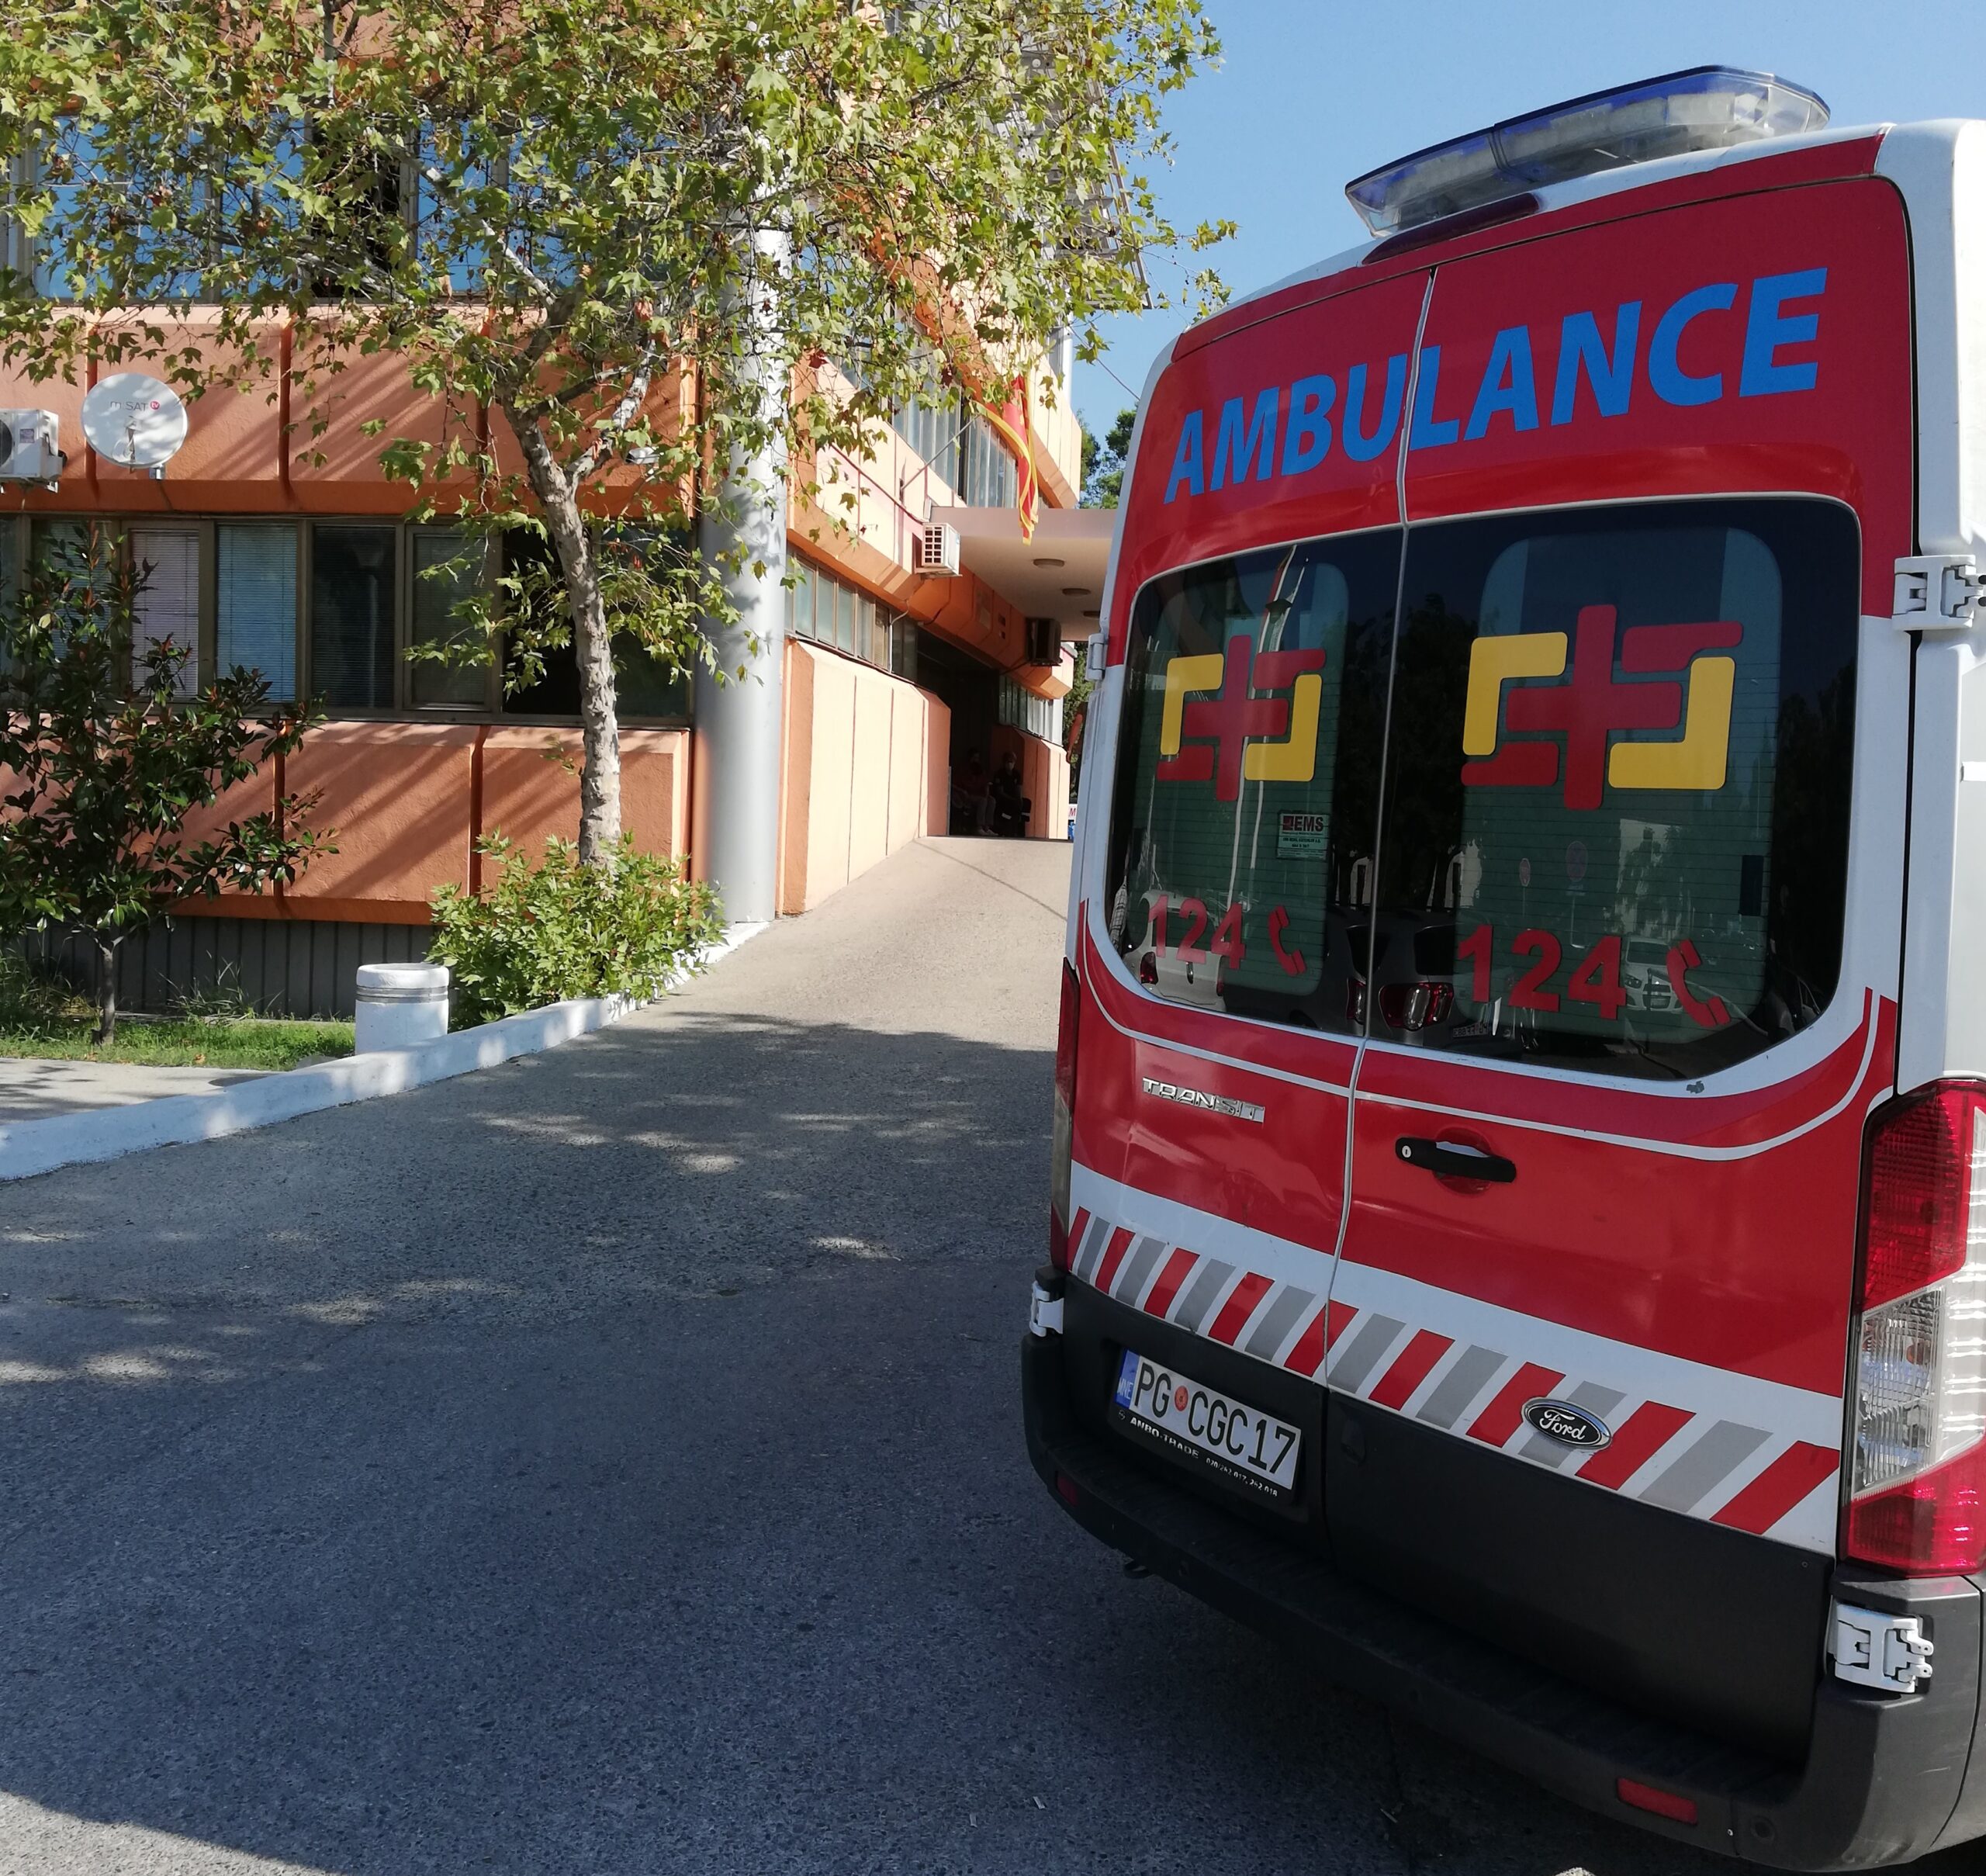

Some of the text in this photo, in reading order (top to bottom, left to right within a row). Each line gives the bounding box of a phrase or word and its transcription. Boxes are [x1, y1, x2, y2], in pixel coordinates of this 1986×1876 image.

[125, 401, 147, 411] SAT
[1164, 267, 1828, 504] AMBULANCE
[1294, 815, 1323, 832] EMS
[1149, 895, 1246, 969] 124
[1457, 924, 1627, 1020] 124
[1142, 1077, 1265, 1123] TRANSIT
[1117, 1377, 1133, 1400] MNE
[1134, 1362, 1296, 1474] PG CGC17
[1539, 1409, 1587, 1440] Ford
